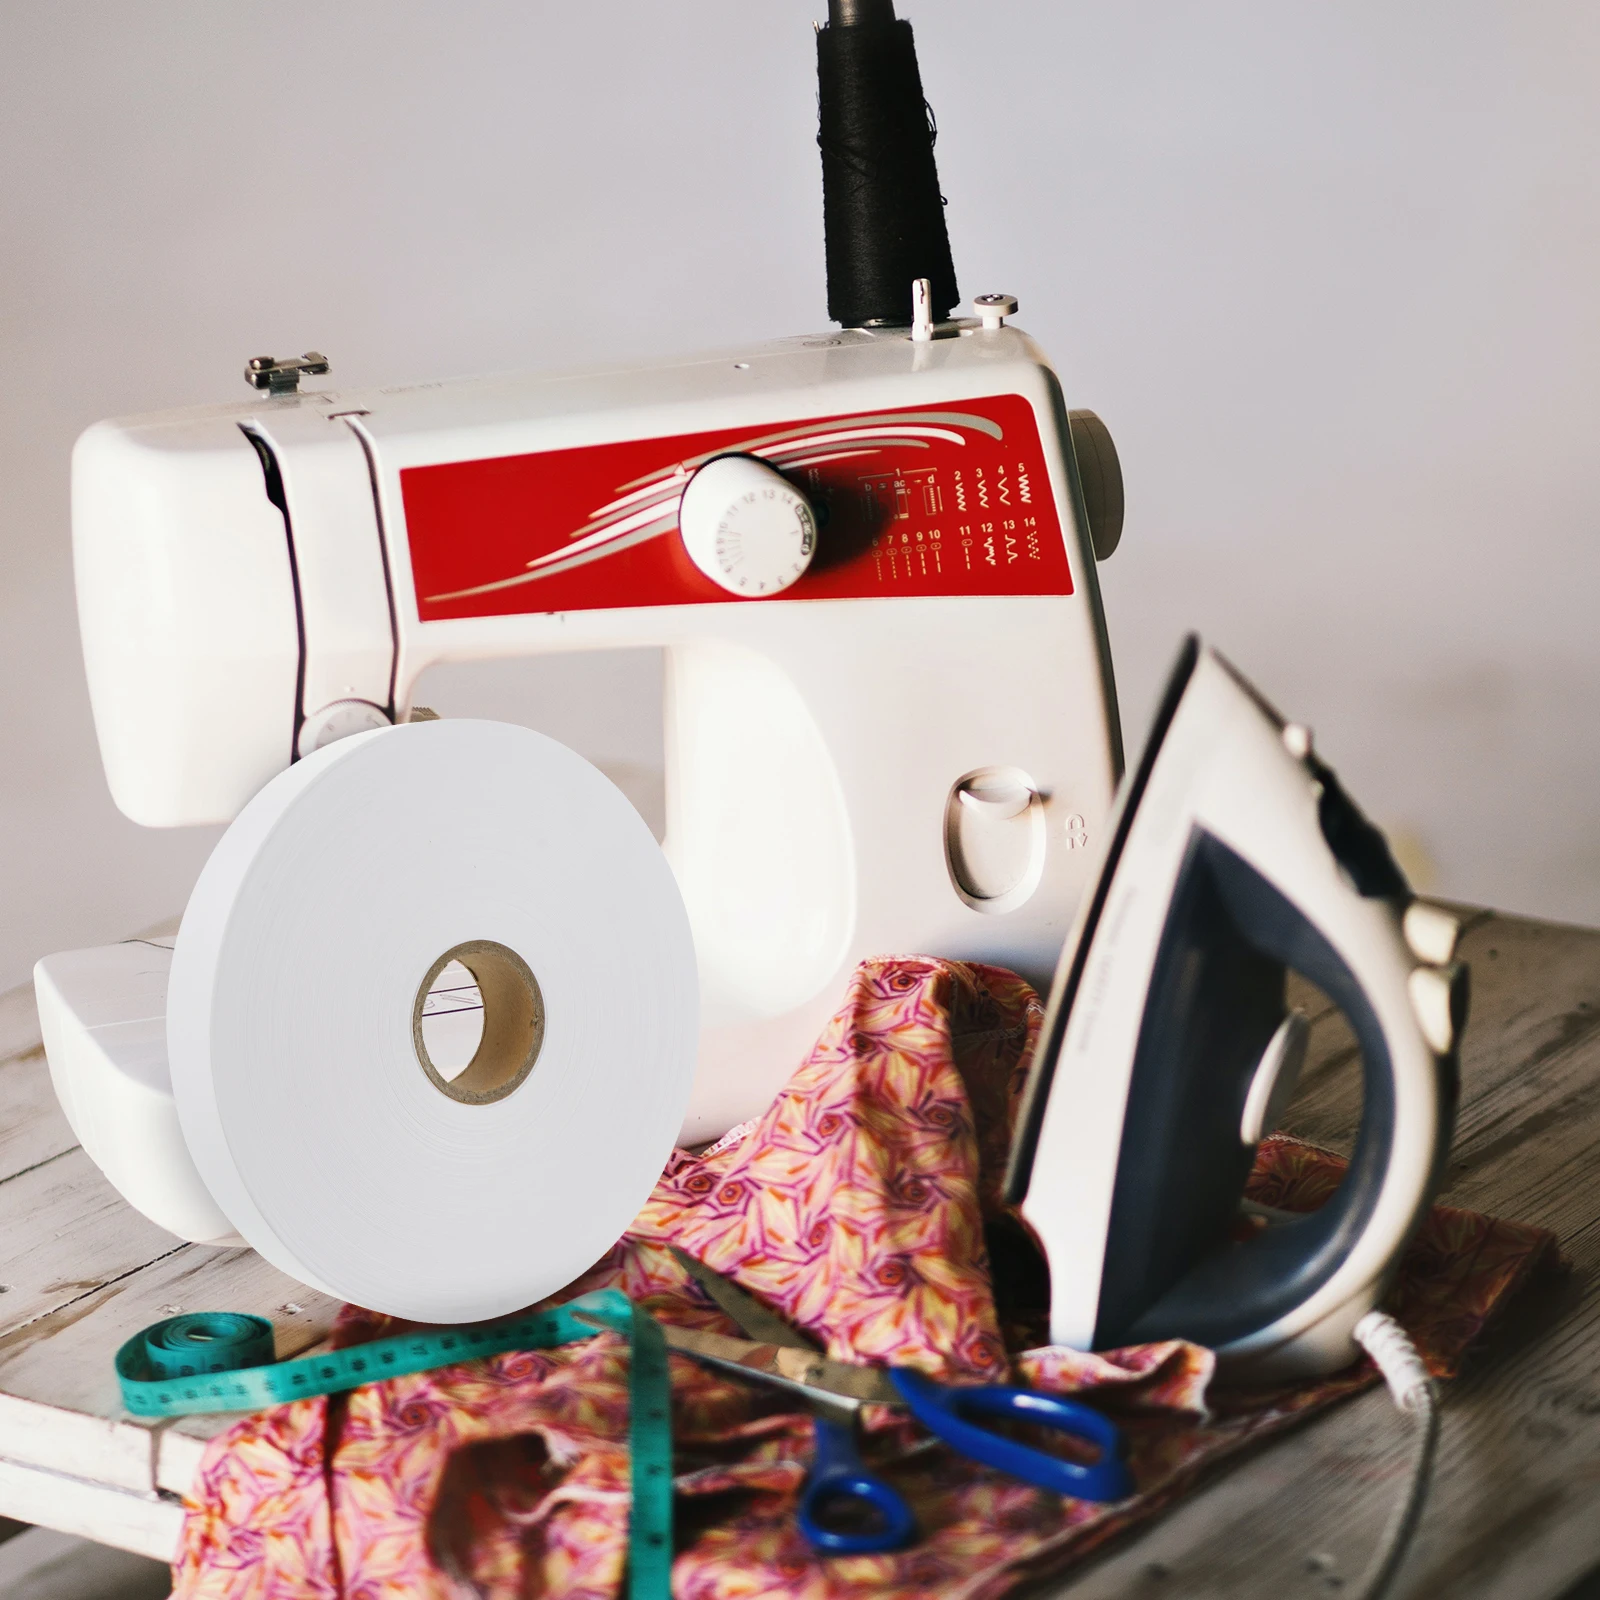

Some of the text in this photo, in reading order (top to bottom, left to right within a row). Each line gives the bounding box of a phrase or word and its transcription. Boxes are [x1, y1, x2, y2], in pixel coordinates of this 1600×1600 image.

[895, 467, 901, 477] 1
[927, 474, 935, 484] d
[954, 462, 1025, 480] 2 3 4 5
[959, 516, 1036, 535] 11 12 13 14
[887, 535, 893, 545] 7
[901, 533, 908, 543] 8
[916, 531, 923, 541] 9
[928, 529, 941, 539] 10
